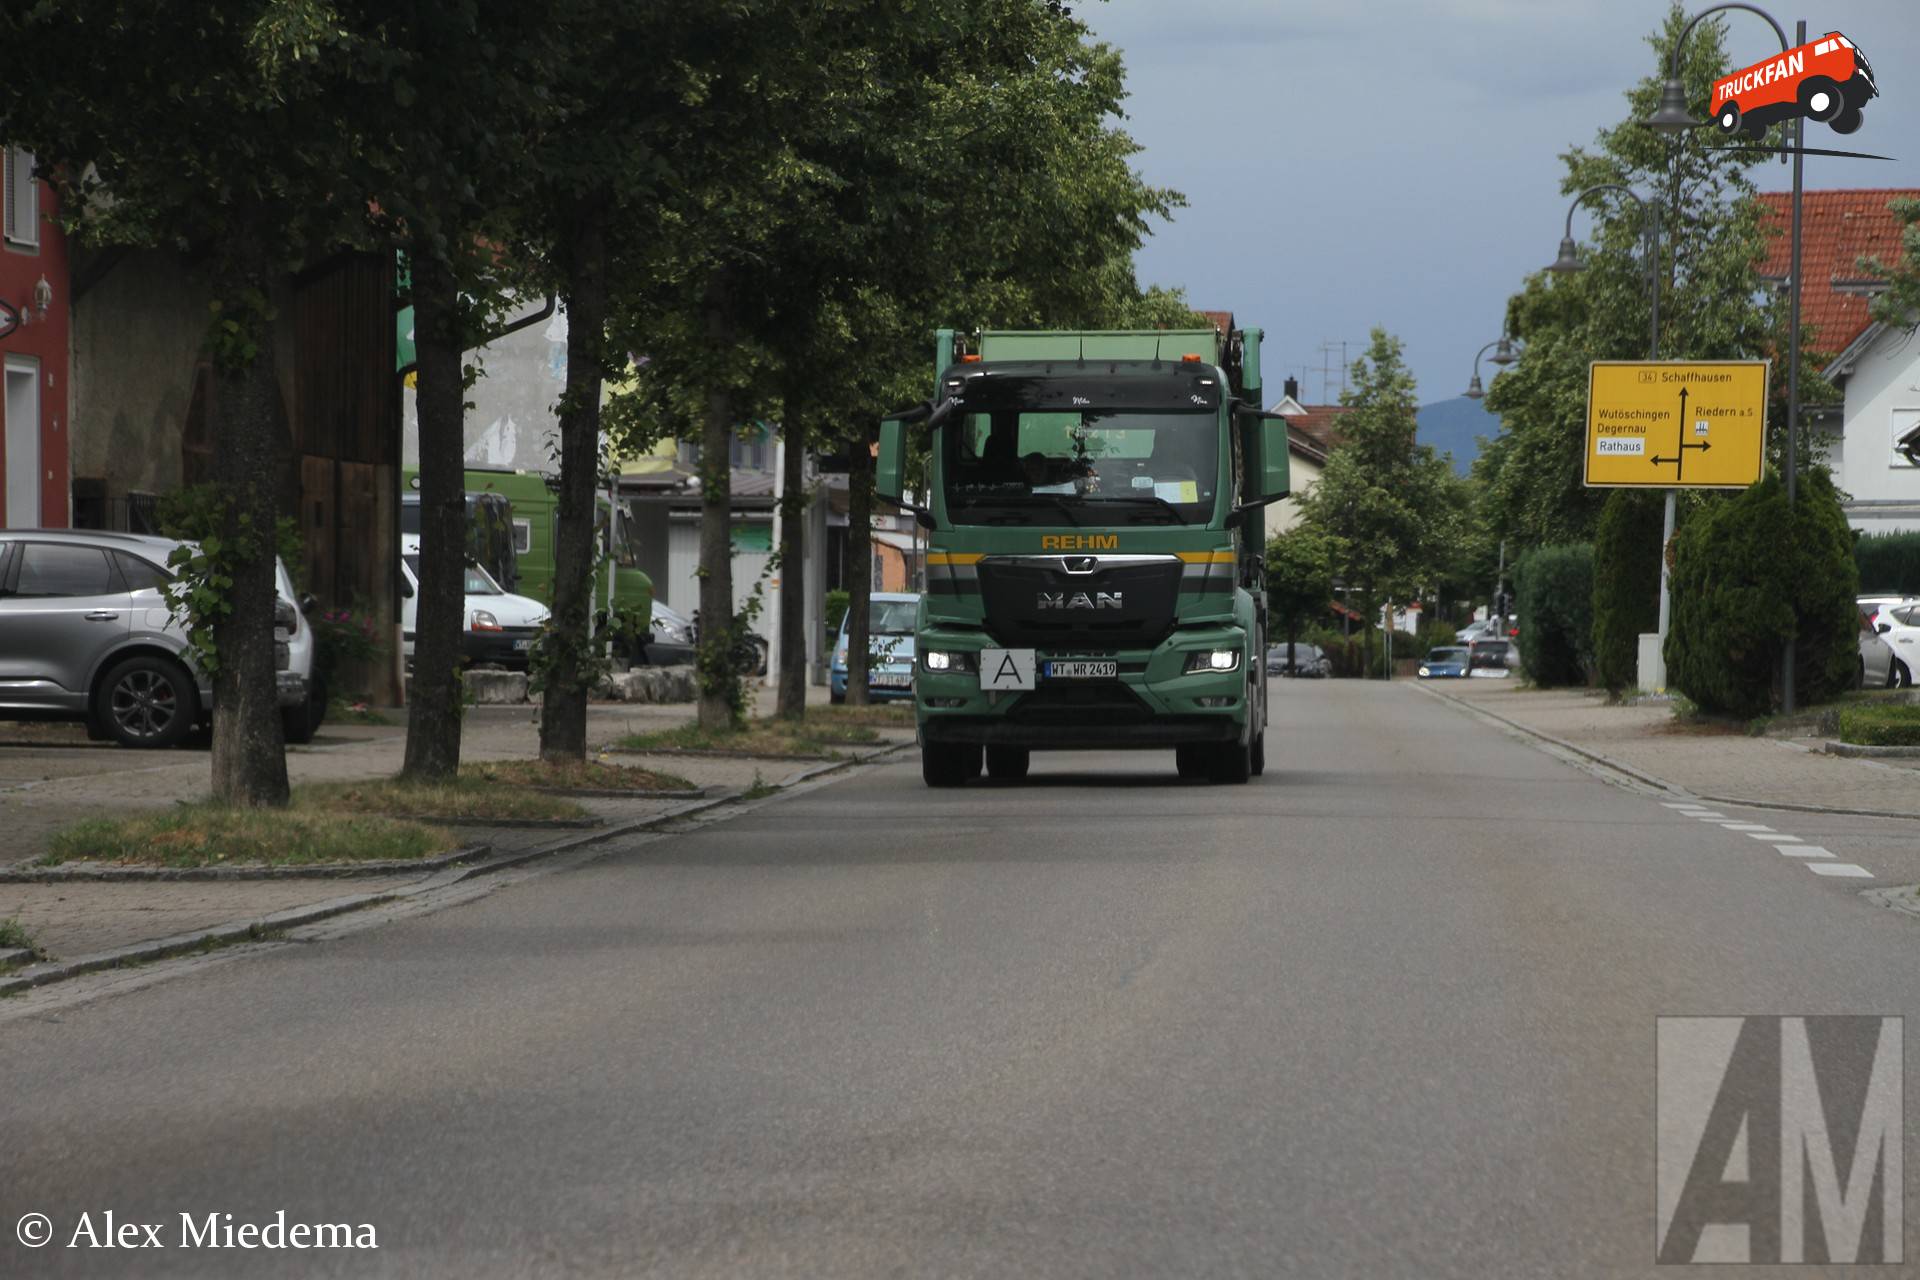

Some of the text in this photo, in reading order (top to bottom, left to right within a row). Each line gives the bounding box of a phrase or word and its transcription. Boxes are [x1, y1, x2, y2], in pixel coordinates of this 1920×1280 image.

[1661, 371, 1732, 383] Schaffhausen
[1598, 408, 1670, 422] Wutöschingen
[1695, 406, 1736, 417] Riedern
[1597, 423, 1646, 436] Degernau
[1599, 441, 1641, 452] Rathaus
[1041, 535, 1118, 549] REHM
[1037, 592, 1123, 609] MAN
[993, 653, 1022, 684] A
[1052, 663, 1116, 675] WT WR 2419
